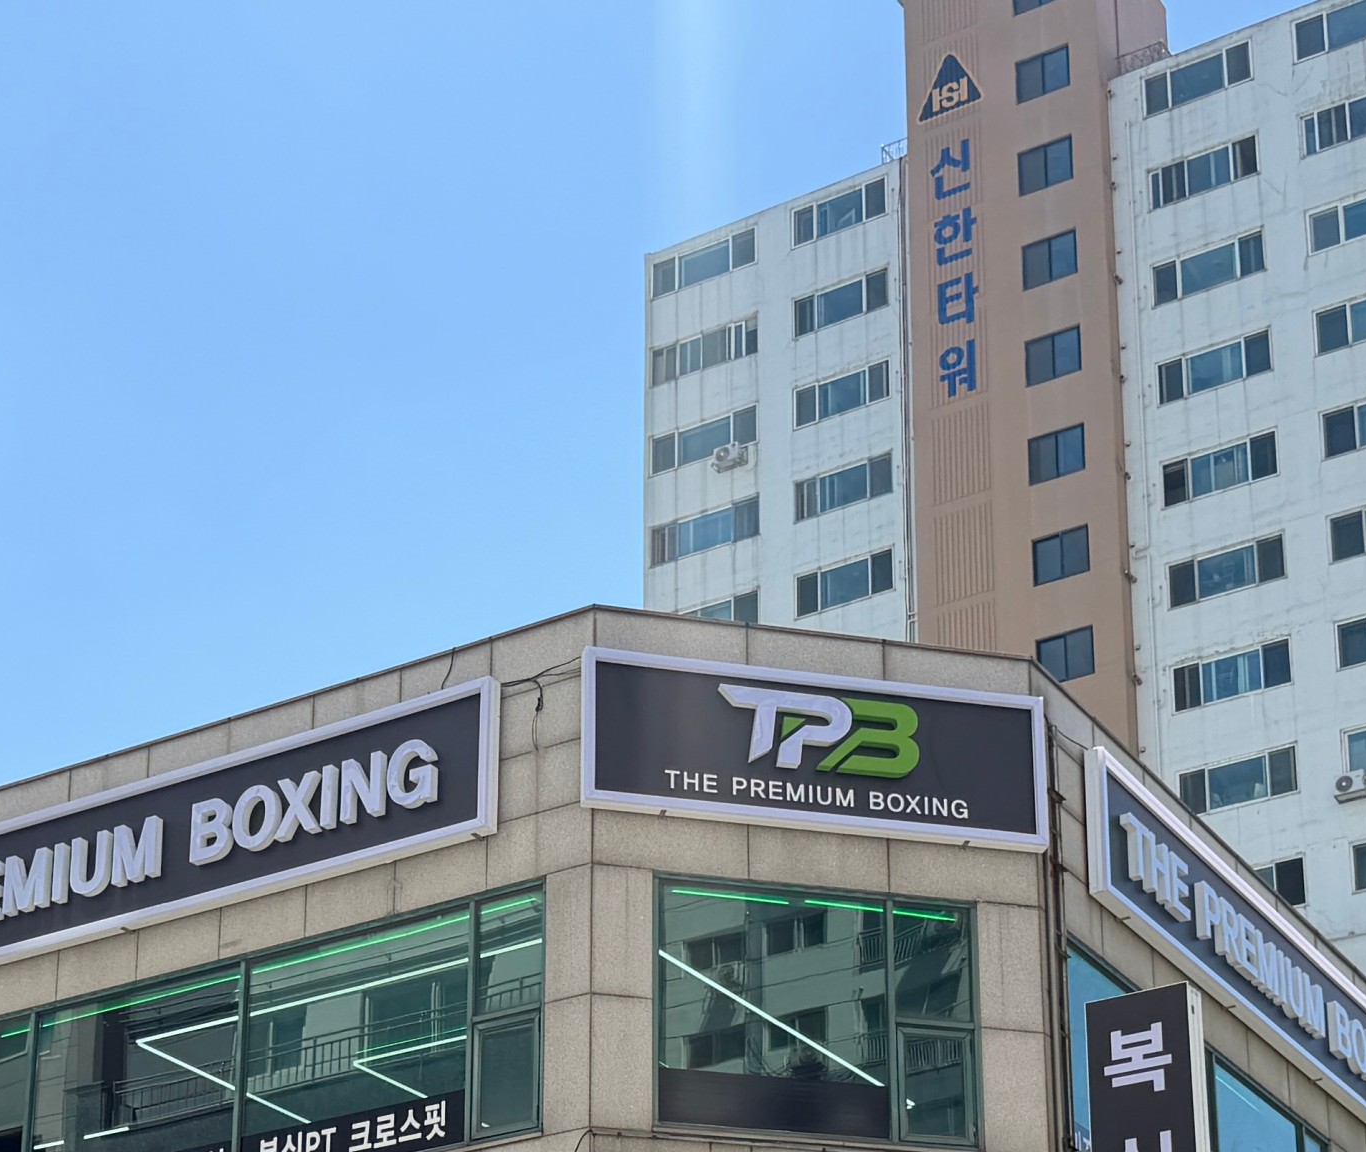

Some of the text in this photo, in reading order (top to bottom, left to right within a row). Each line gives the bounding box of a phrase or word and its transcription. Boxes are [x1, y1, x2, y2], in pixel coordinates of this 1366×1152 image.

[930, 139, 977, 398] 신한타워
[664, 769, 969, 820] THE PREMIUM BOXING
[717, 682, 921, 779] TPB
[189, 738, 439, 866] BOXING
[1119, 812, 1191, 922] THE
[1195, 881, 1326, 1039] PREMIUM
